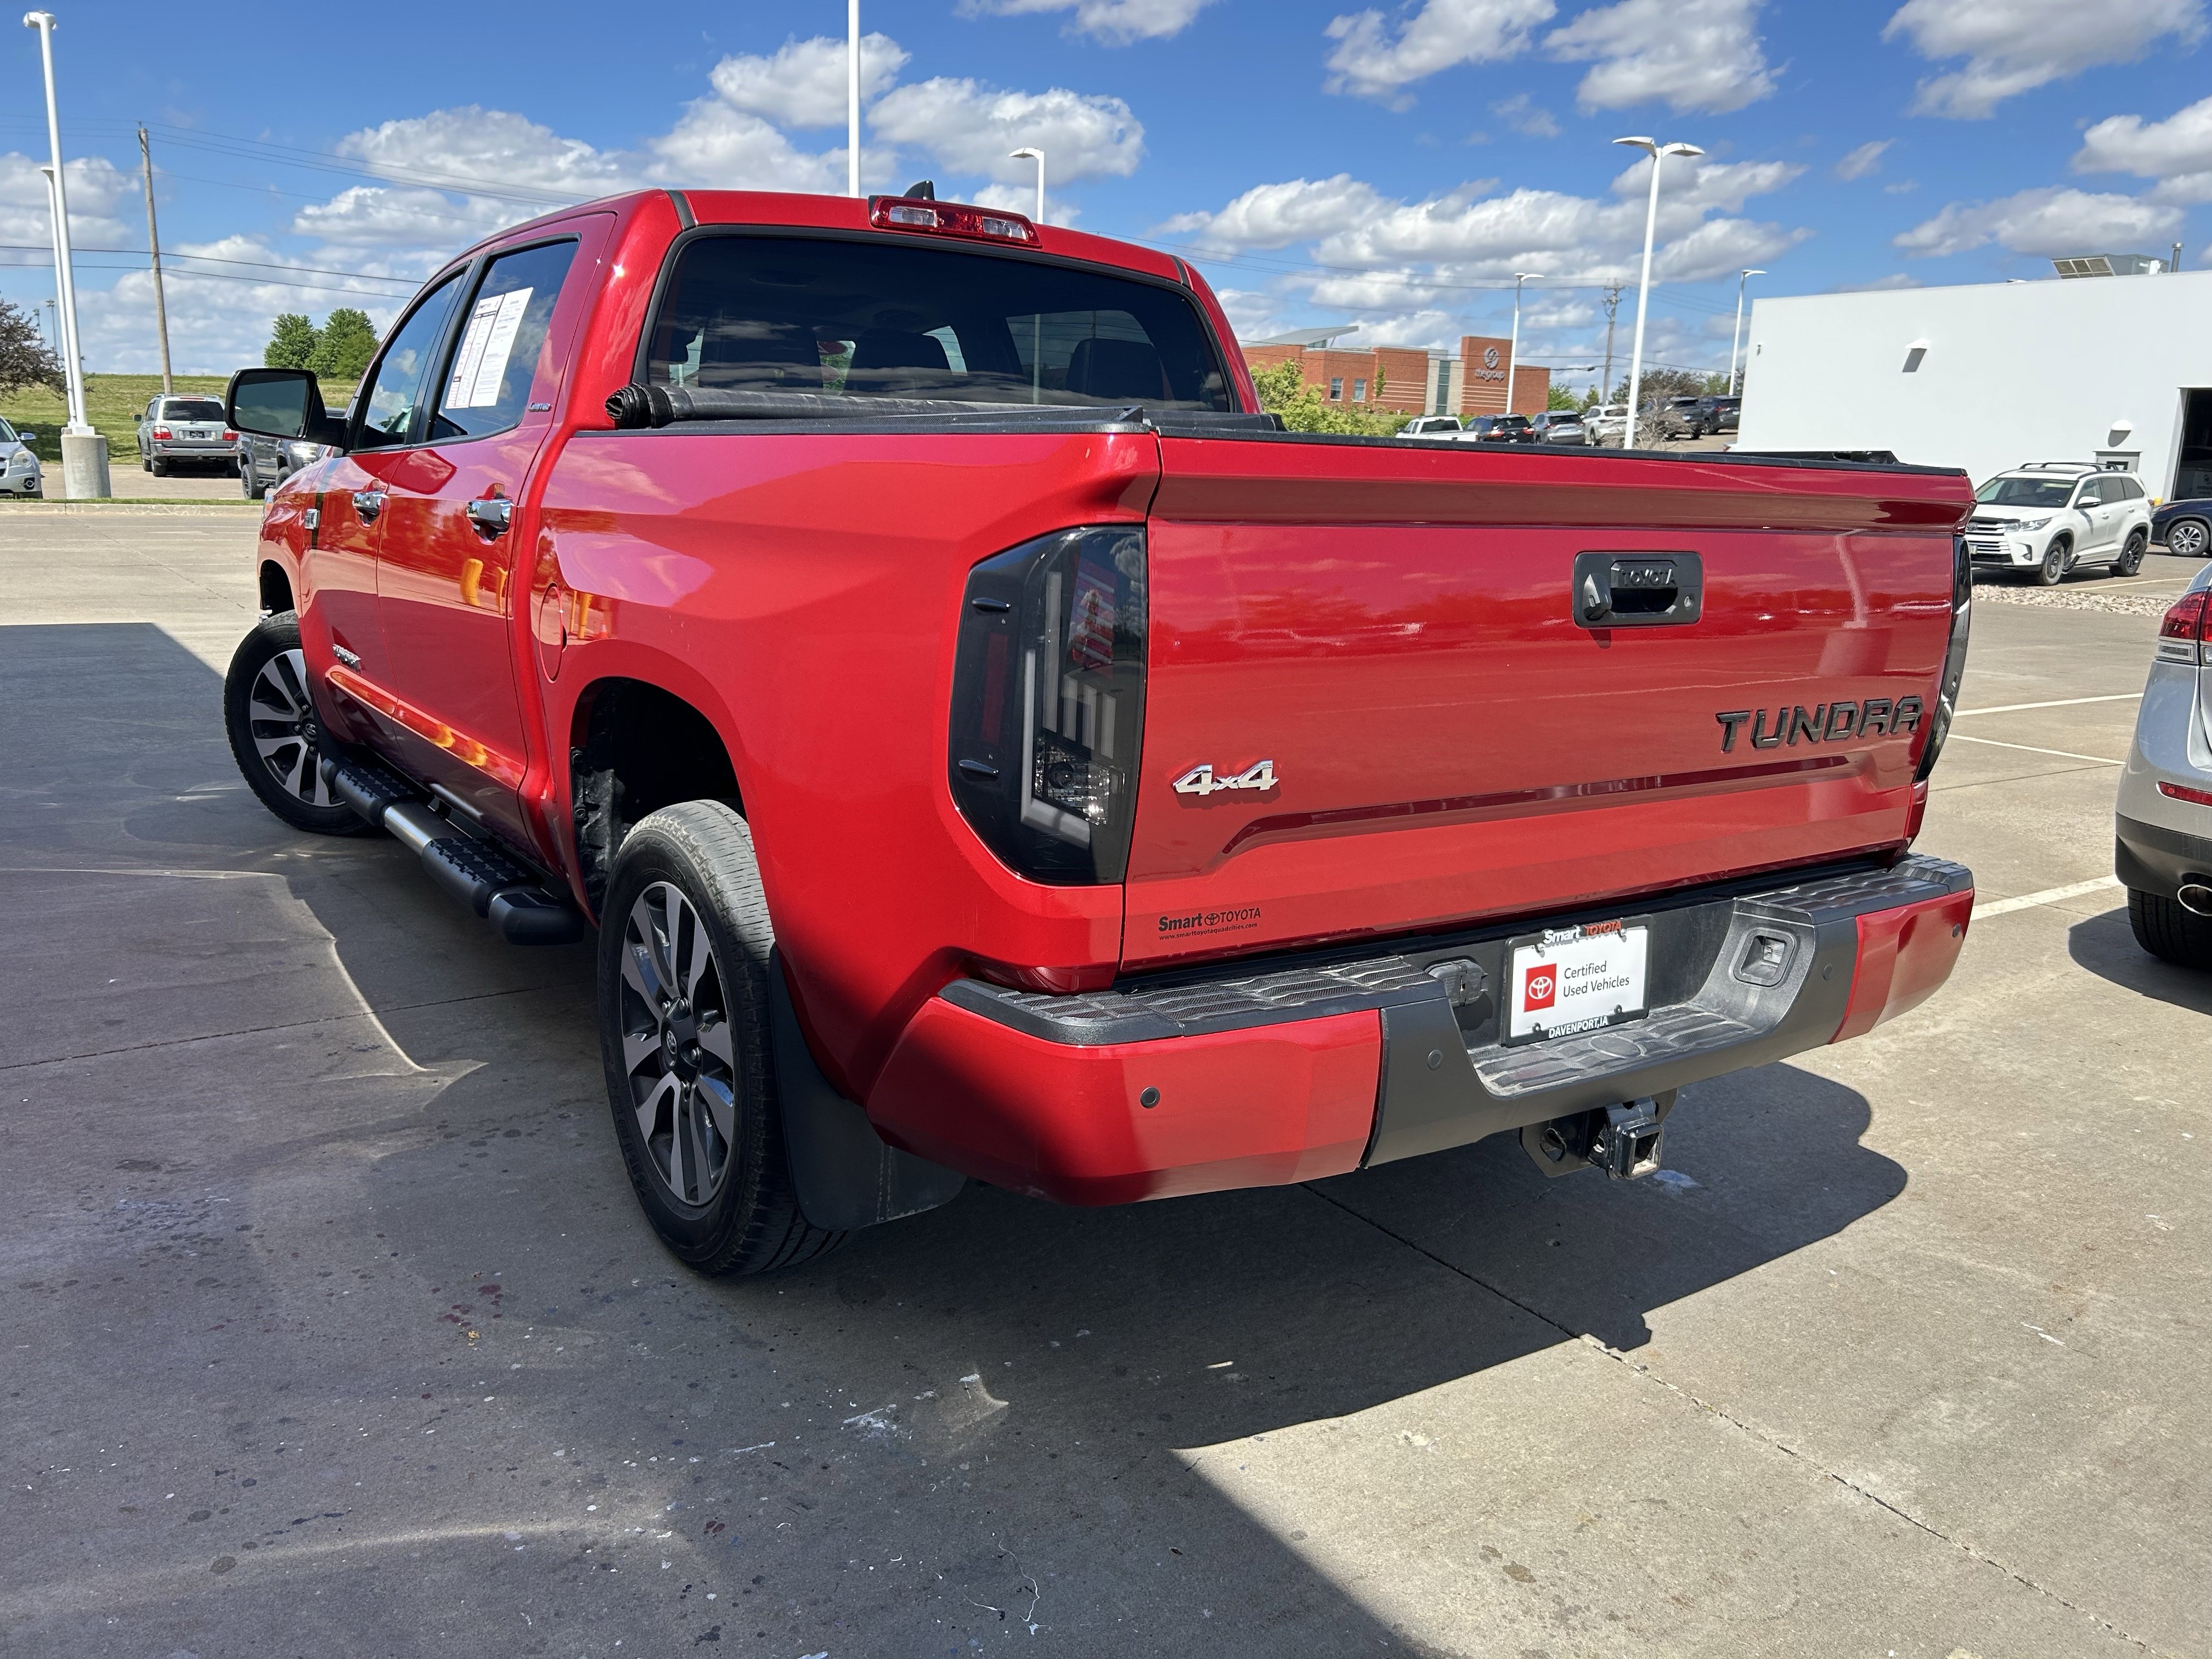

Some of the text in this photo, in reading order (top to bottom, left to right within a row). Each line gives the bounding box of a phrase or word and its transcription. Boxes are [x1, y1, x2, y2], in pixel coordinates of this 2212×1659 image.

[1621, 568, 1677, 586] TOYOTA
[1715, 694, 1923, 754] TUNDRA
[1172, 759, 1279, 796] 4x4
[1159, 907, 1261, 932] Smart TOYOTA
[1543, 921, 1622, 944] Smart TOYOTA
[1564, 960, 1607, 979] Certified
[1563, 975, 1630, 997] Used Vehicles
